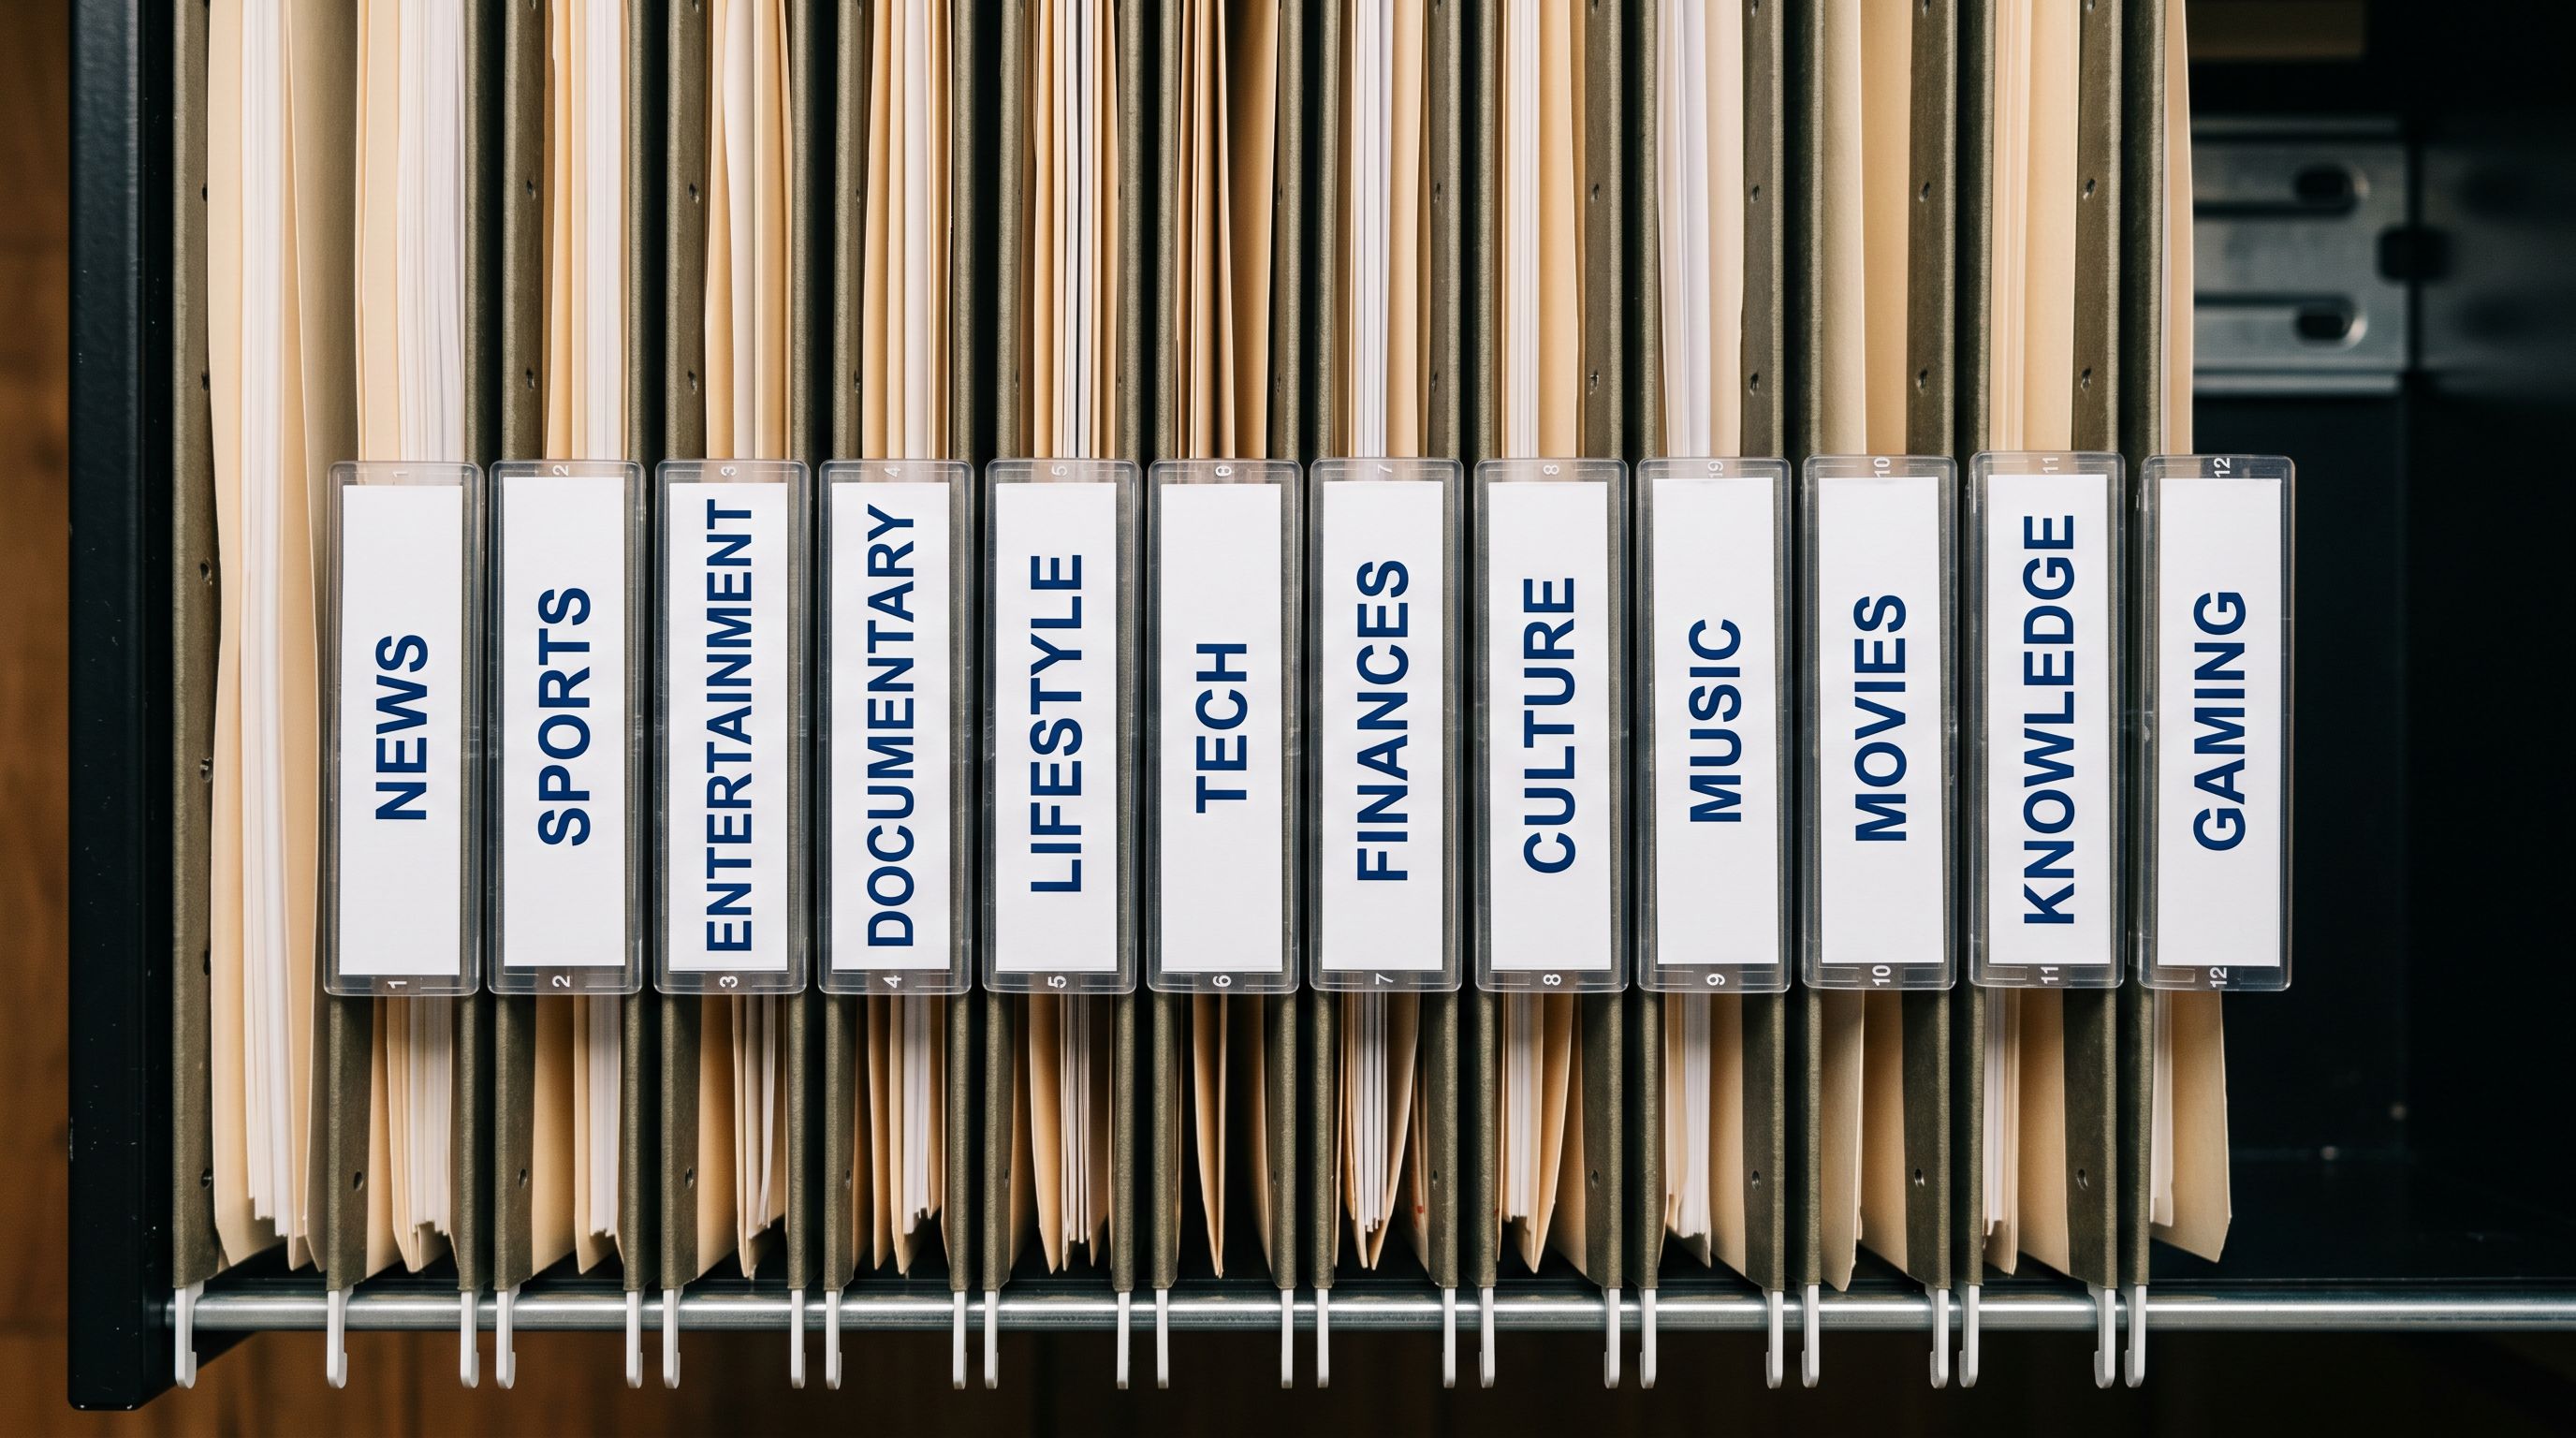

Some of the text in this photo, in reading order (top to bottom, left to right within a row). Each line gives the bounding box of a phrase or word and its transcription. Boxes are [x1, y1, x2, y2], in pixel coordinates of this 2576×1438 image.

[375, 635, 429, 820] NEWS
[538, 587, 591, 845] SPORTS
[706, 499, 753, 951] ENTERTAINMENT
[867, 505, 915, 946] DOCUMENTARY
[1030, 554, 1083, 892] LIFESTYLE
[1194, 643, 1247, 814] TECH
[1357, 560, 1409, 881] FINANCES
[1523, 578, 1576, 873] CULTURE
[1689, 619, 1742, 822] MUSIC
[1853, 594, 1907, 841] MOVIES
[2022, 515, 2075, 924] KNOWLEDGE
[2193, 591, 2247, 850] GAMING
[552, 976, 570, 987] 2
[720, 976, 738, 988] 3
[883, 976, 901, 988] 4
[1047, 976, 1067, 989] 5
[1212, 975, 1231, 987] 6
[1376, 973, 1393, 984] 7
[1541, 974, 1560, 986] 8
[1705, 974, 1725, 986] 9
[1872, 965, 1891, 986] 10
[2041, 966, 2058, 983] 11
[2210, 966, 2228, 988] 12
